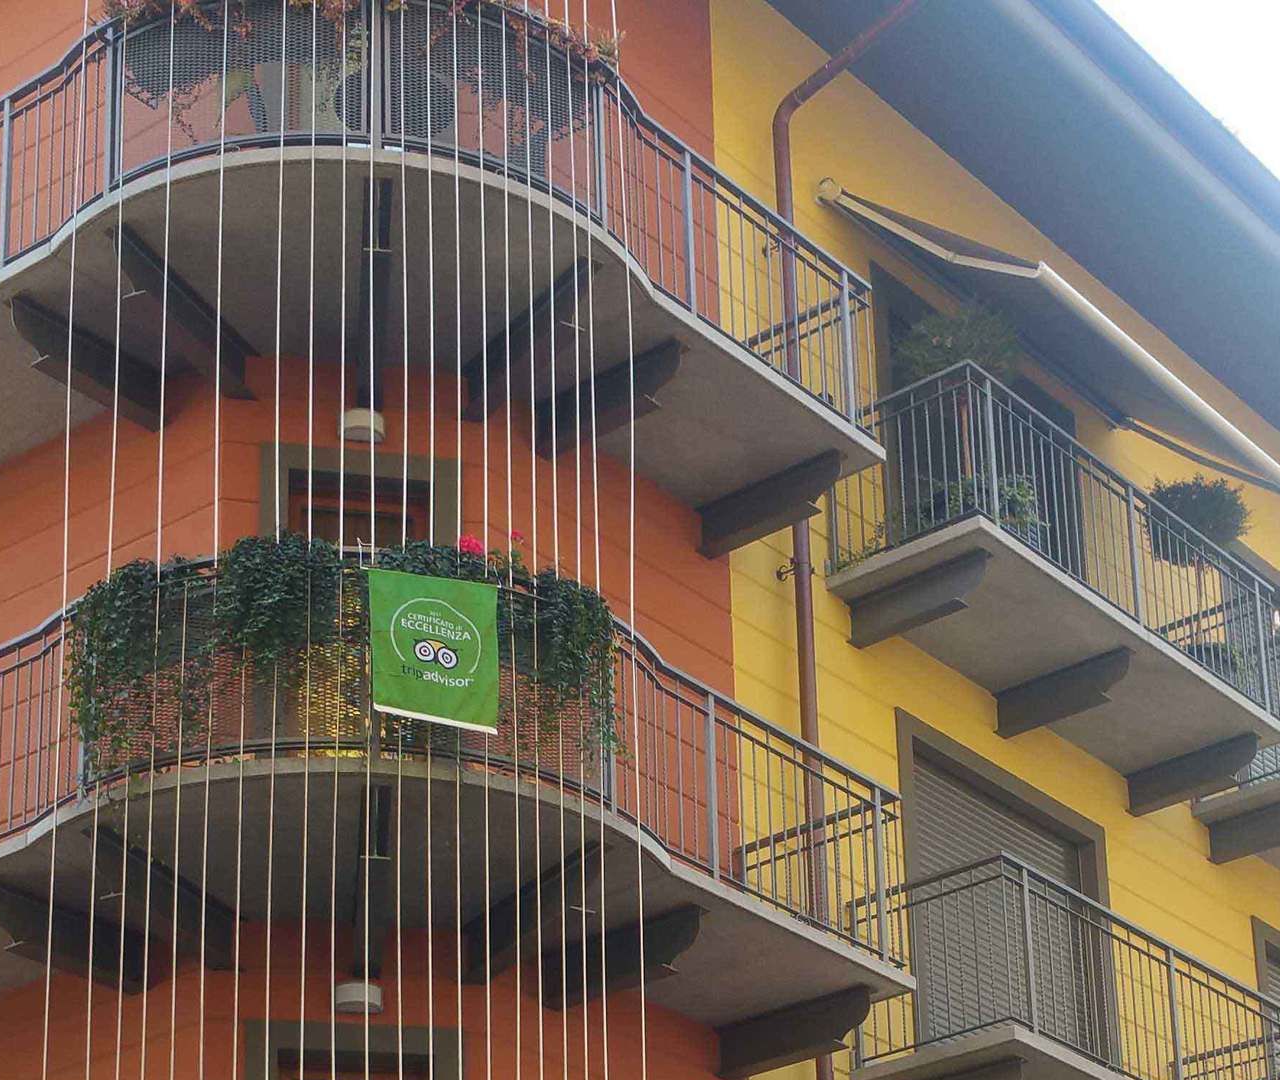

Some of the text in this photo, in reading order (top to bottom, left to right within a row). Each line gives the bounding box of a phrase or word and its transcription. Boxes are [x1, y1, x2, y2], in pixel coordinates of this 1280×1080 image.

[401, 617, 472, 641] ECCELLENZA
[407, 612, 454, 630] CERTIFICATO
[401, 663, 472, 688] tripadvisor
